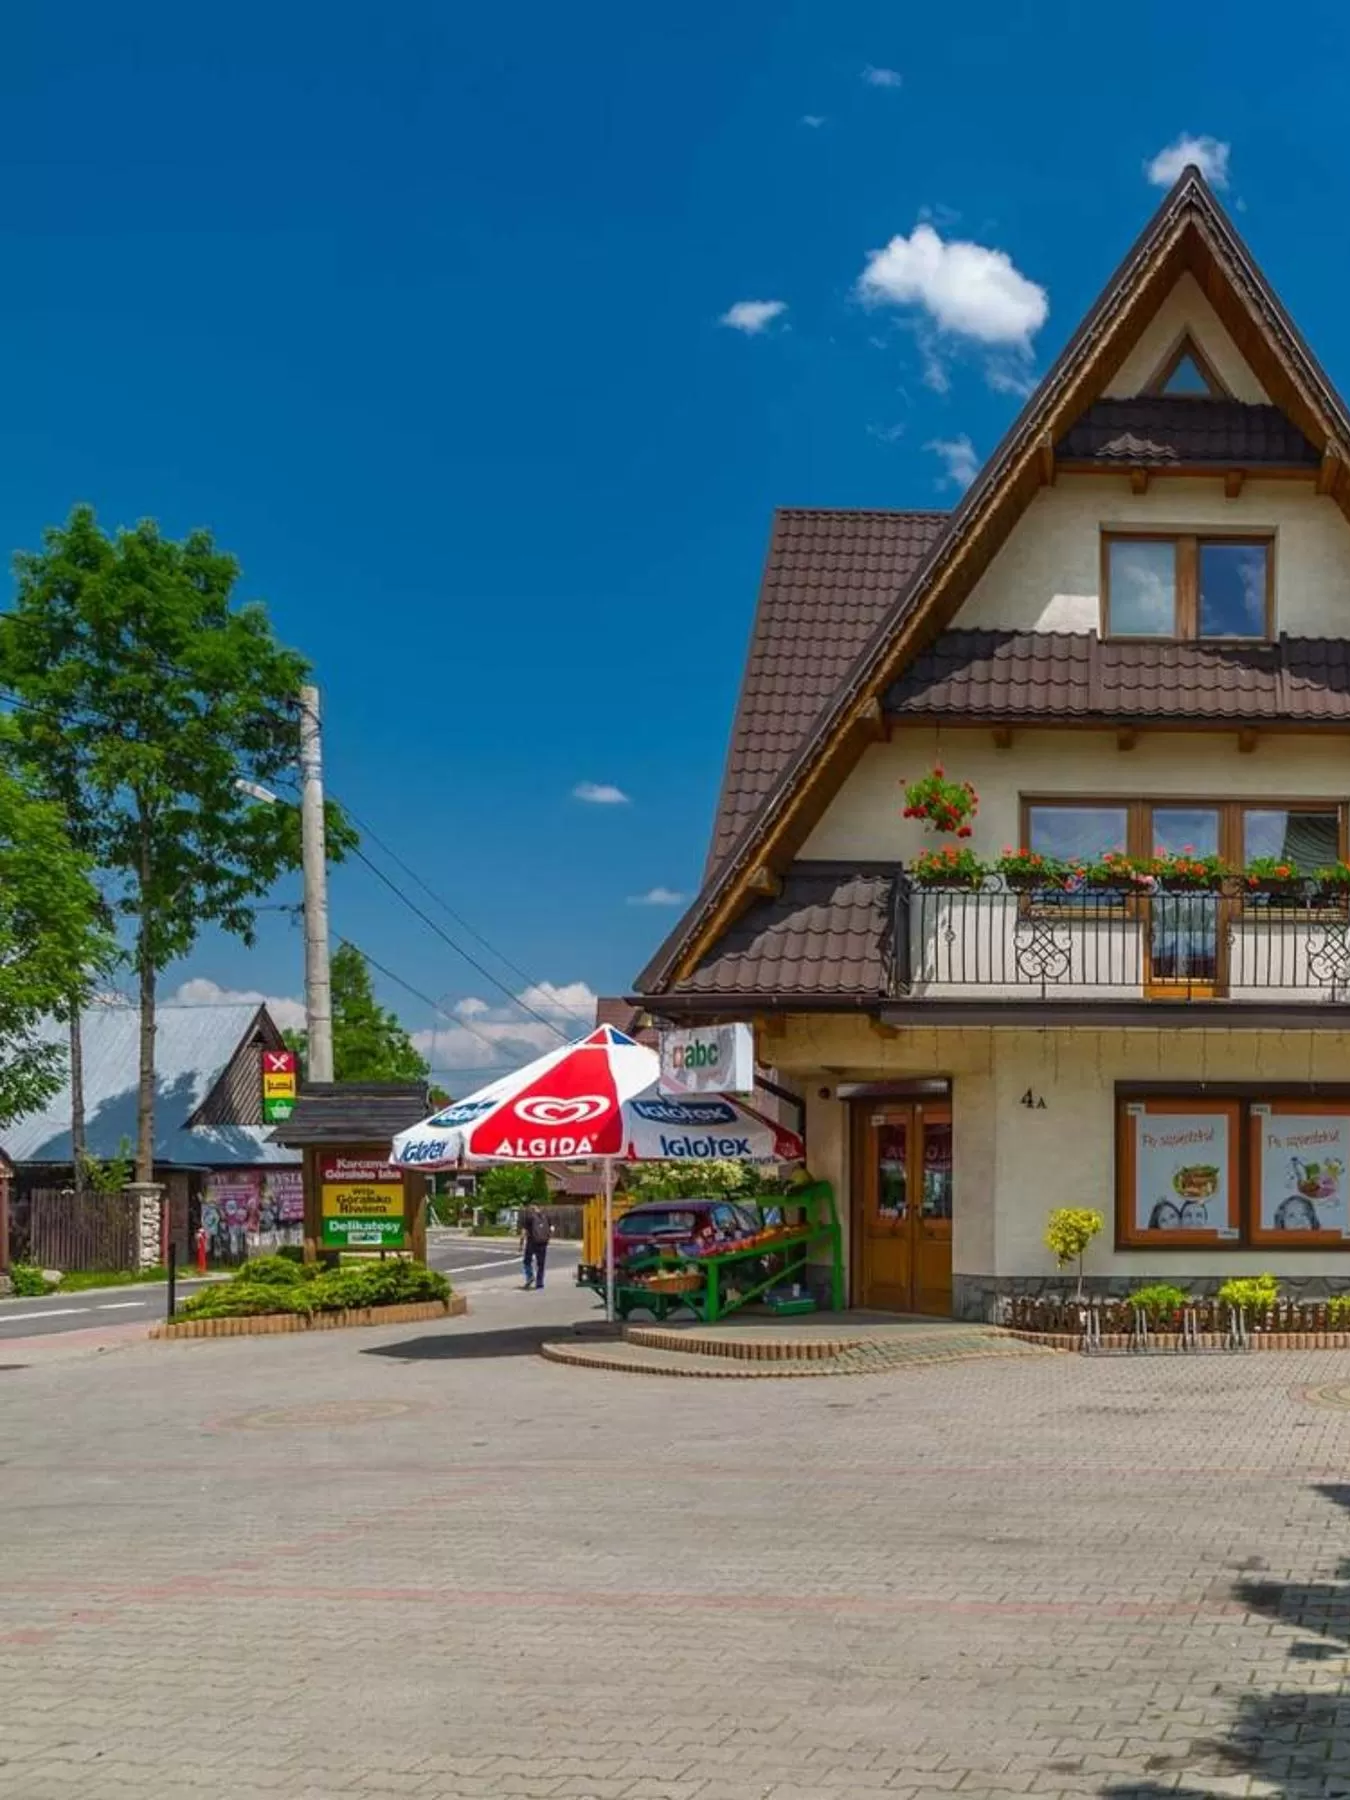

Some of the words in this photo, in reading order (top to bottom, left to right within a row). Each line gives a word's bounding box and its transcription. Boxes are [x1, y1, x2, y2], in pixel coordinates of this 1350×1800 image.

[685, 1040, 718, 1068] abc
[634, 1102, 728, 1120] Iglotex
[493, 1137, 594, 1157] ALGIDA
[660, 1135, 752, 1158] Iglotex
[328, 1219, 401, 1234] Delikatesy
